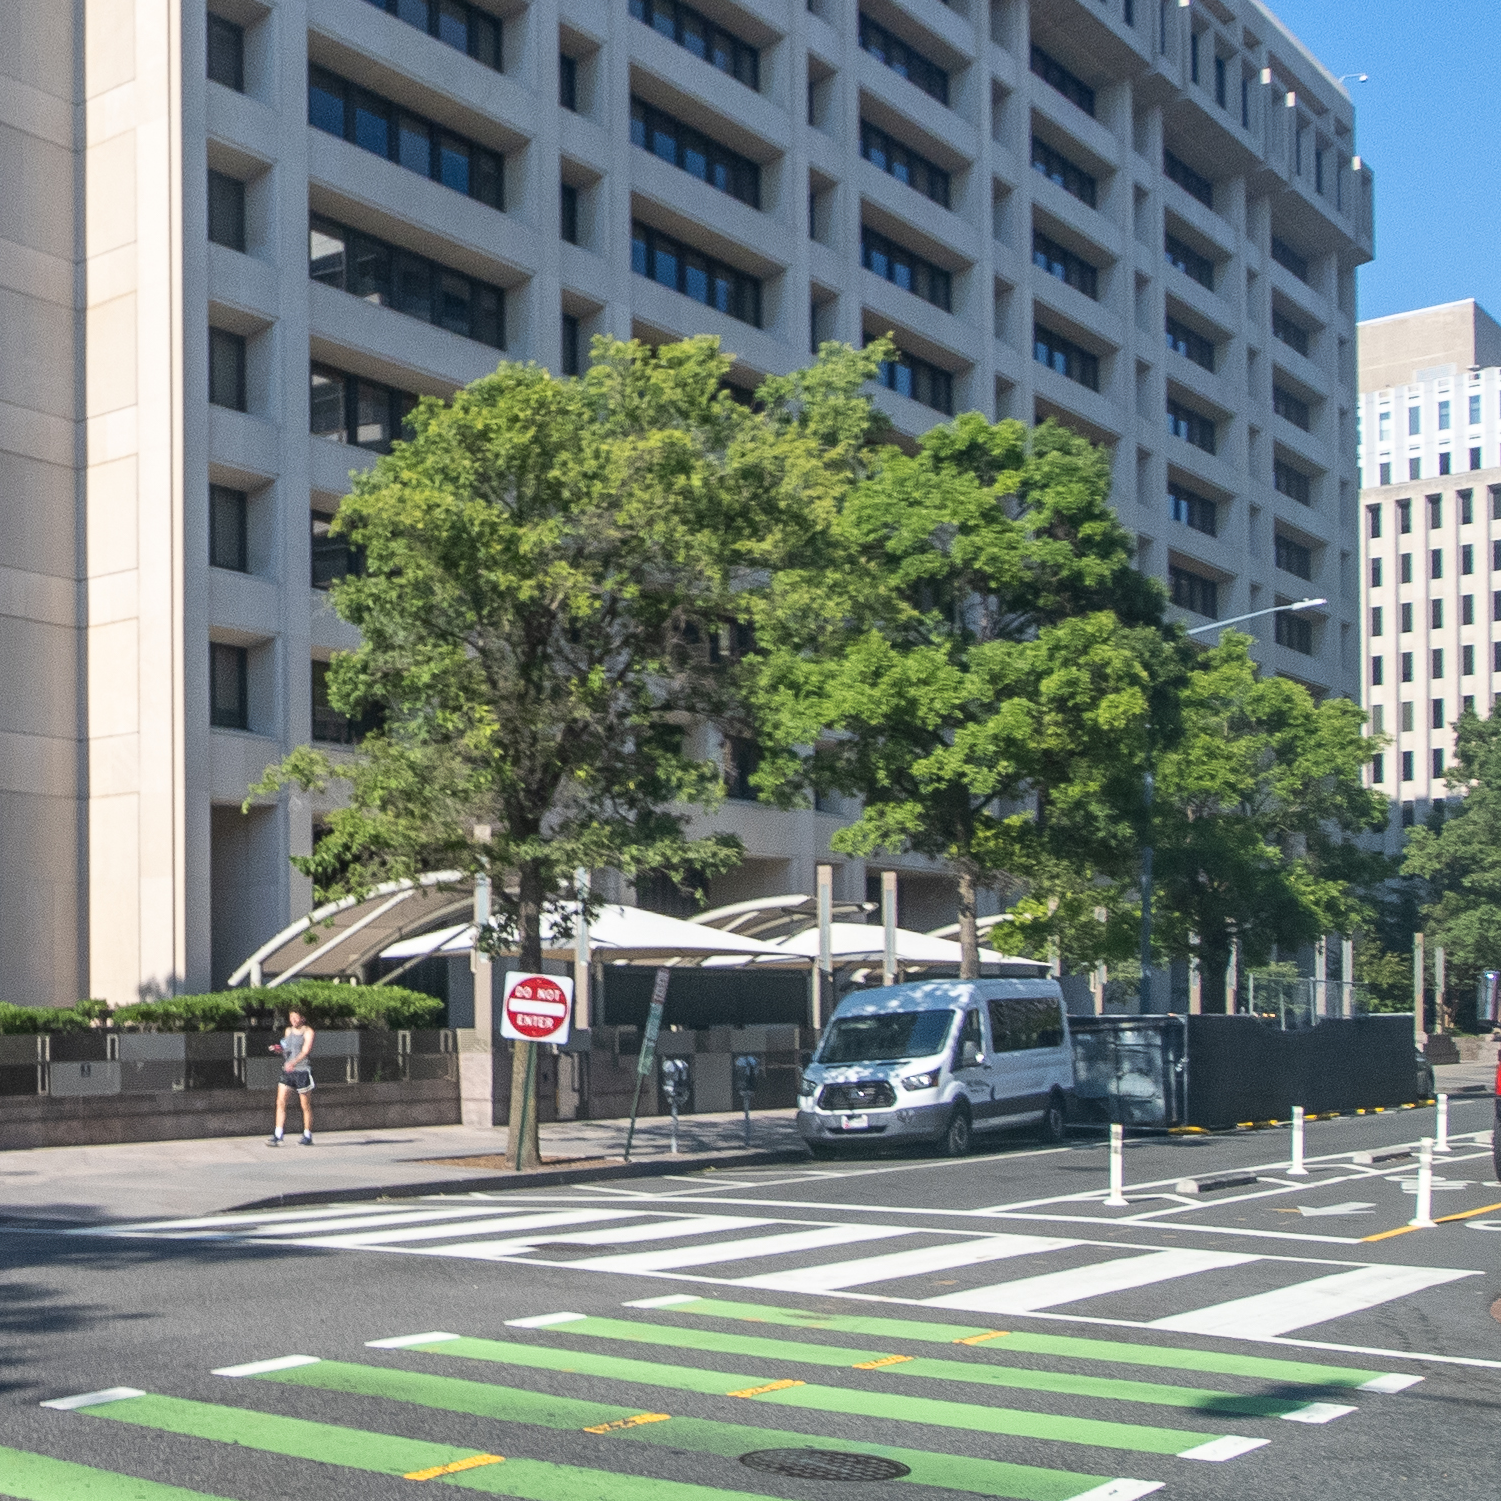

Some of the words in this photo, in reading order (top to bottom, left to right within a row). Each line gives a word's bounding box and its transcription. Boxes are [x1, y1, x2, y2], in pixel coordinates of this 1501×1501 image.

[515, 986, 532, 998] DO
[537, 988, 561, 1001] NOT
[516, 1014, 554, 1029] ENTER
